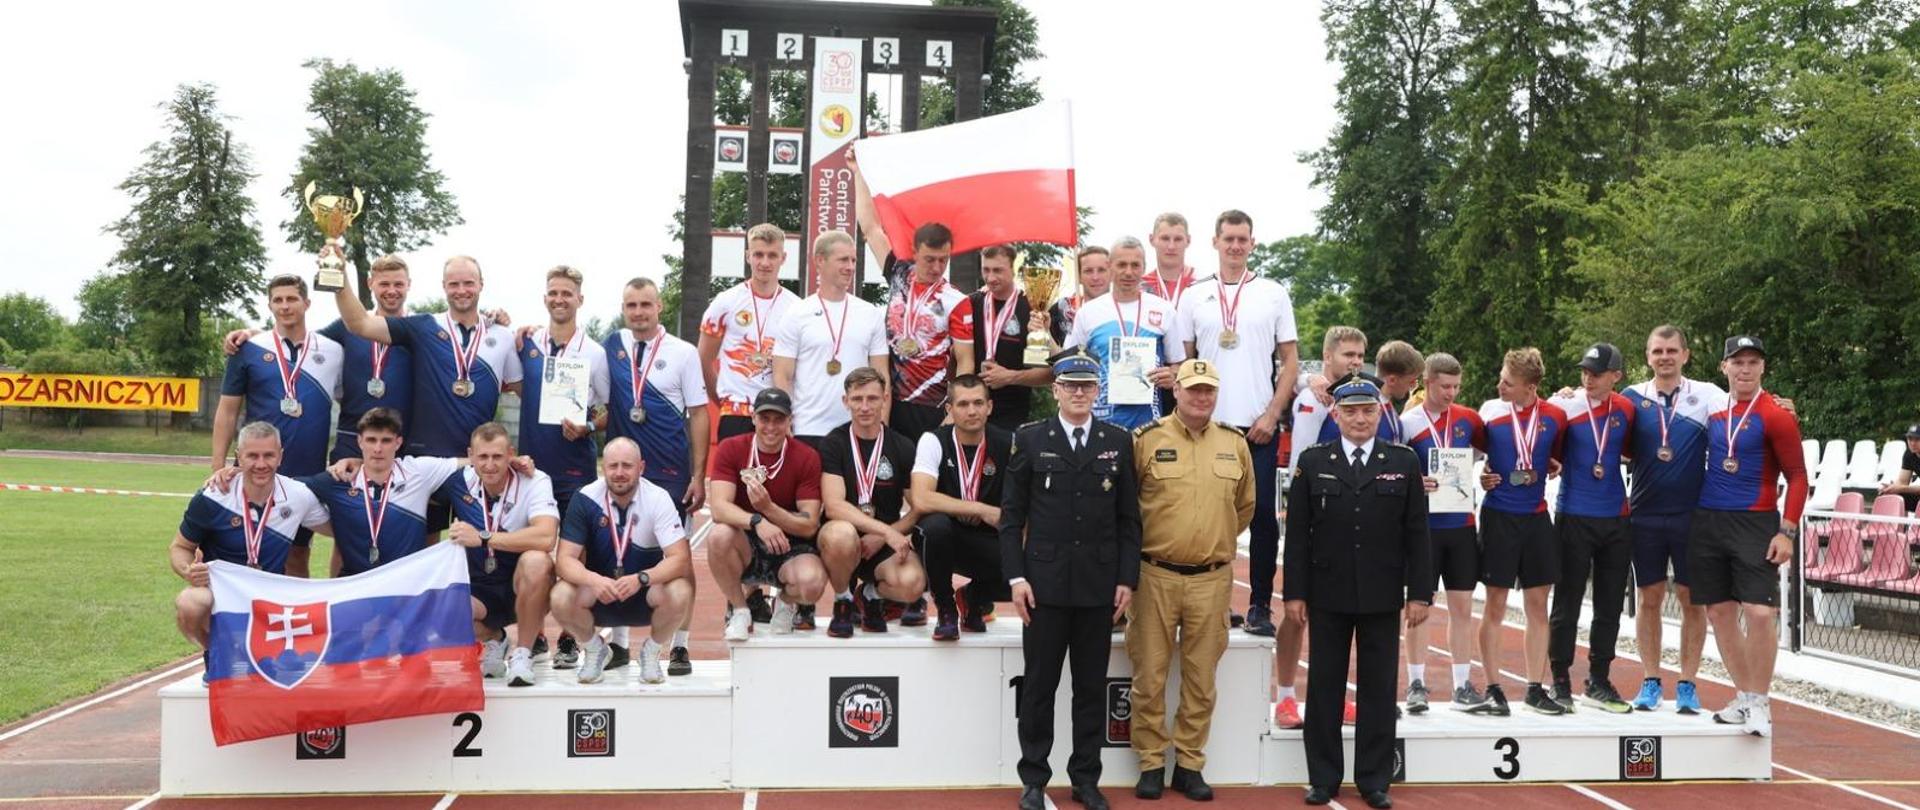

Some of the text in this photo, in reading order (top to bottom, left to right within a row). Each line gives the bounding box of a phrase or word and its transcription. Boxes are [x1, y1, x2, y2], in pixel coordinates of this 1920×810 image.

[730, 35, 739, 51] 1
[784, 38, 796, 54] 2
[880, 42, 892, 59] 3
[933, 46, 945, 61] 4
[852, 703, 874, 724] 40
[453, 712, 482, 757] 2
[1493, 736, 1520, 780] 3
